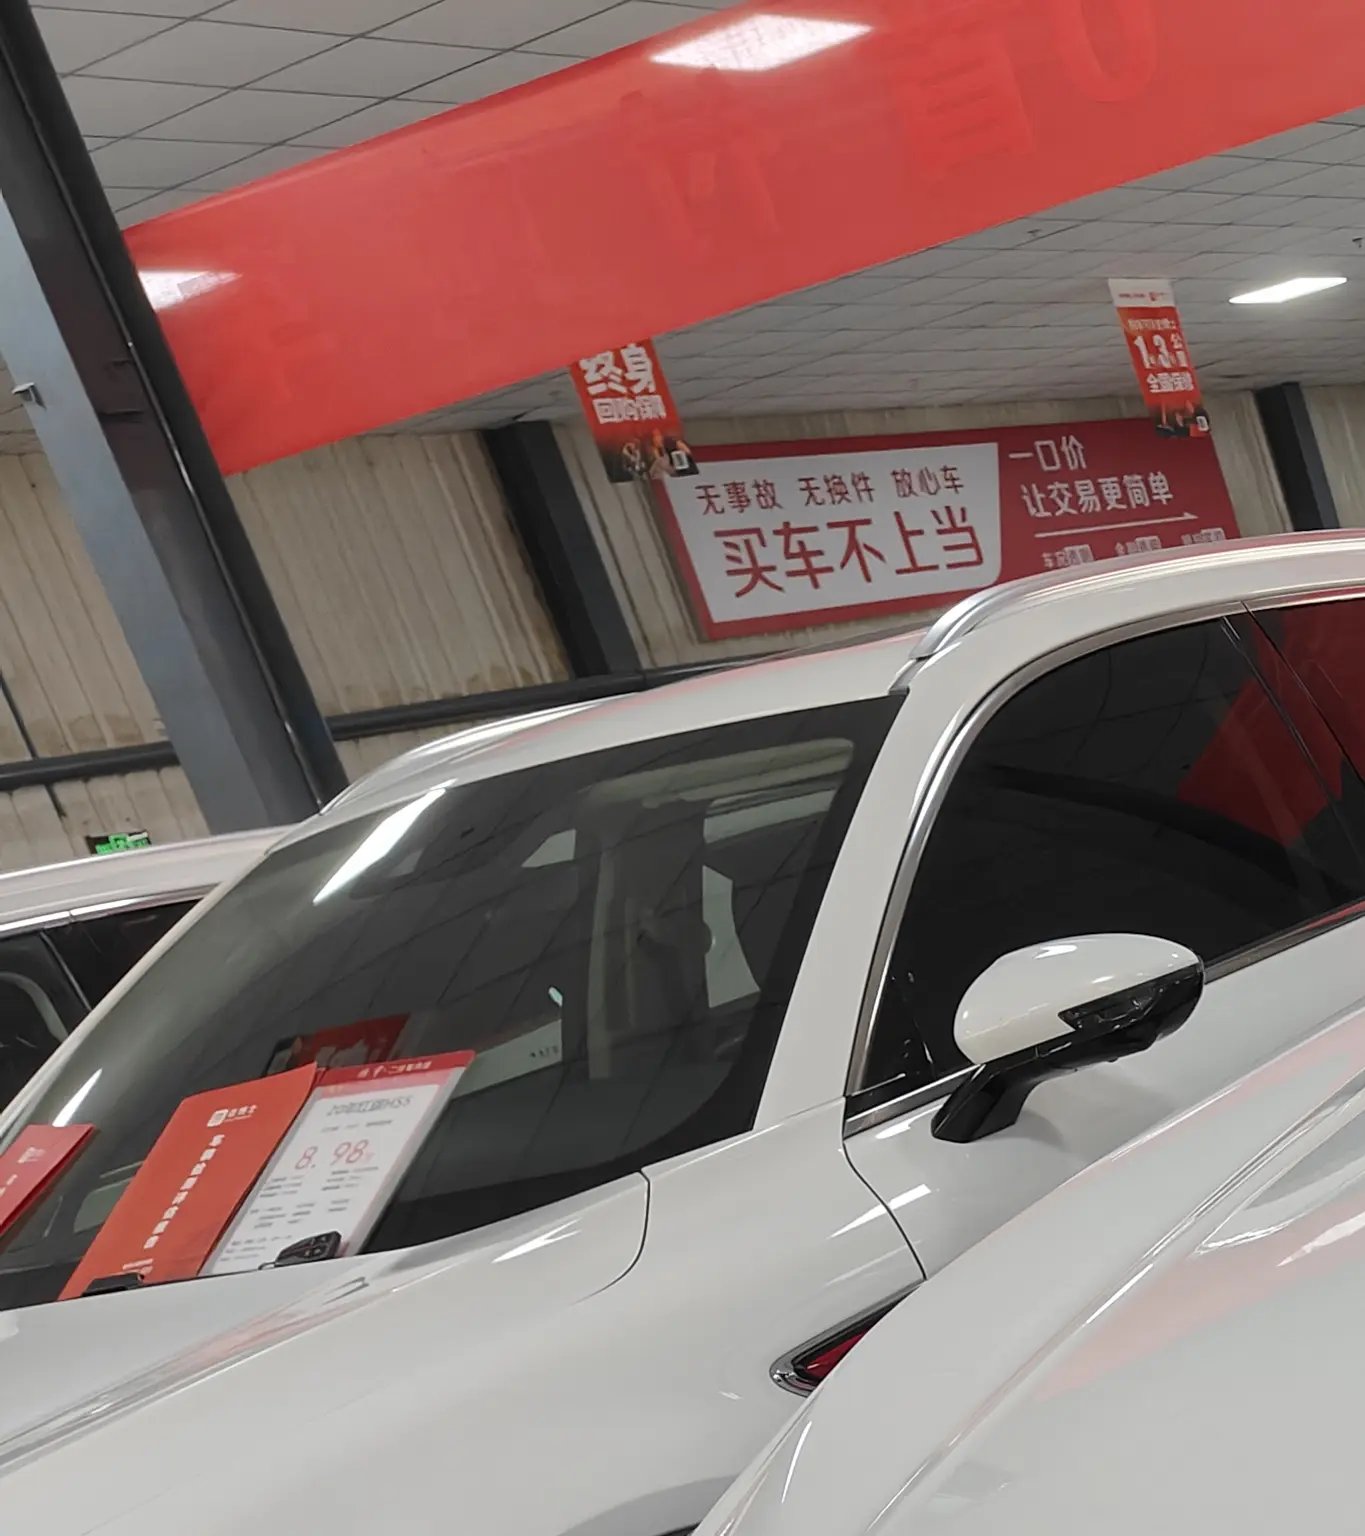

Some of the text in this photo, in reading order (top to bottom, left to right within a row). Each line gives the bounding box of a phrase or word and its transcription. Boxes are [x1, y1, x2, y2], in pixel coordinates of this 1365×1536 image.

[579, 343, 656, 395] 终身
[1008, 435, 1088, 472] 一口价
[695, 464, 964, 515] 无事故 无换件 放心车
[1020, 471, 1174, 518] 让交易更简单
[713, 505, 984, 598] 买车不上当
